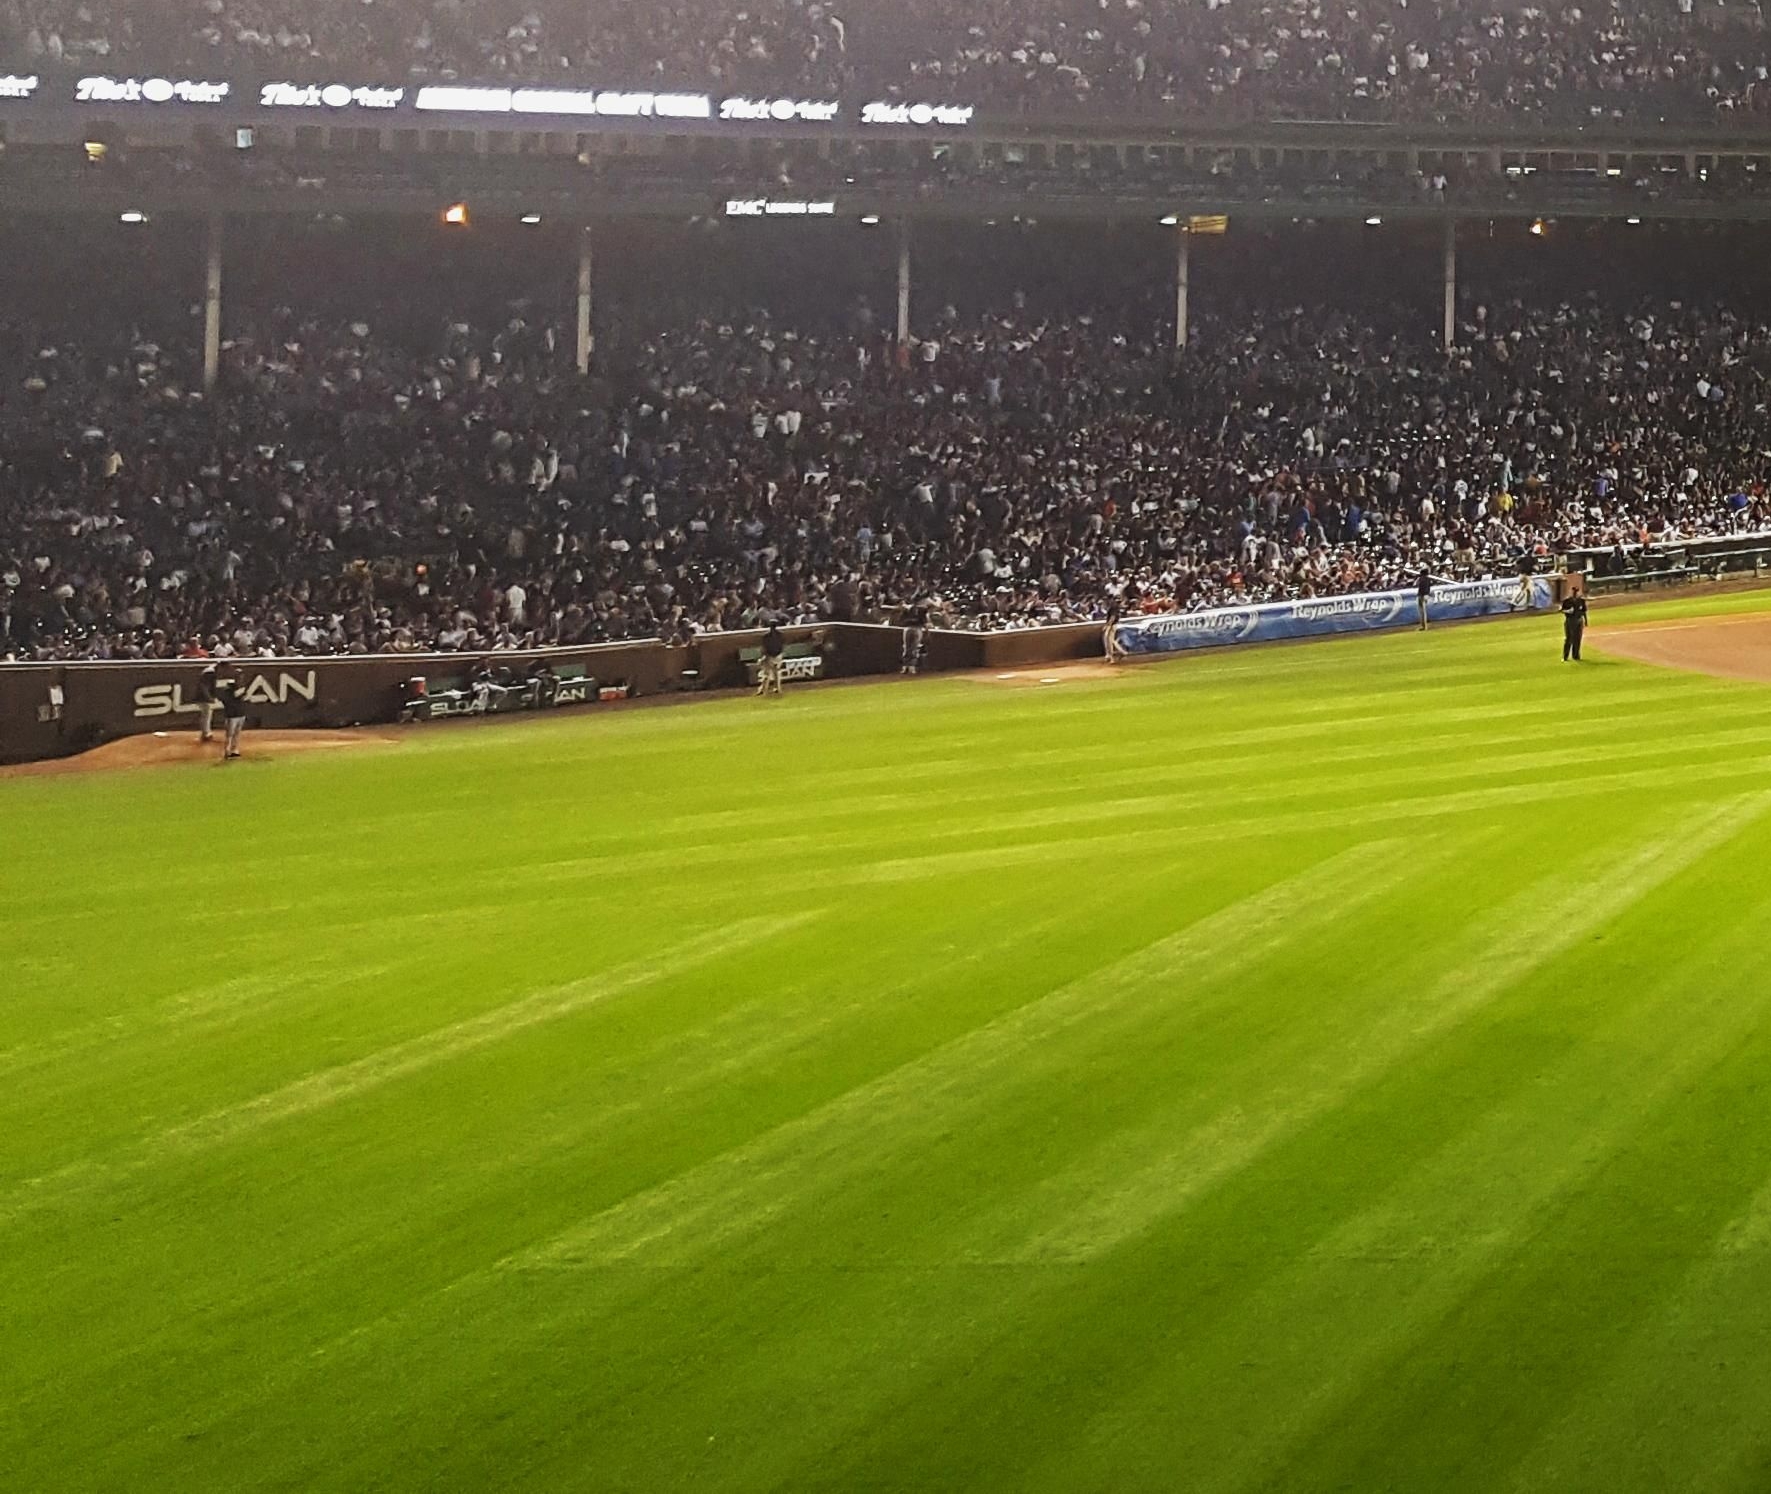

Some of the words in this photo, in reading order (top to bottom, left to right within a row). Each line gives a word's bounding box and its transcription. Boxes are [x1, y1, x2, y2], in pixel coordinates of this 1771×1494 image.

[1433, 587, 1489, 604] Reynolds
[1291, 601, 1351, 621] Reynolds
[1351, 597, 1386, 613] Wrap
[1203, 614, 1242, 630] Wrap
